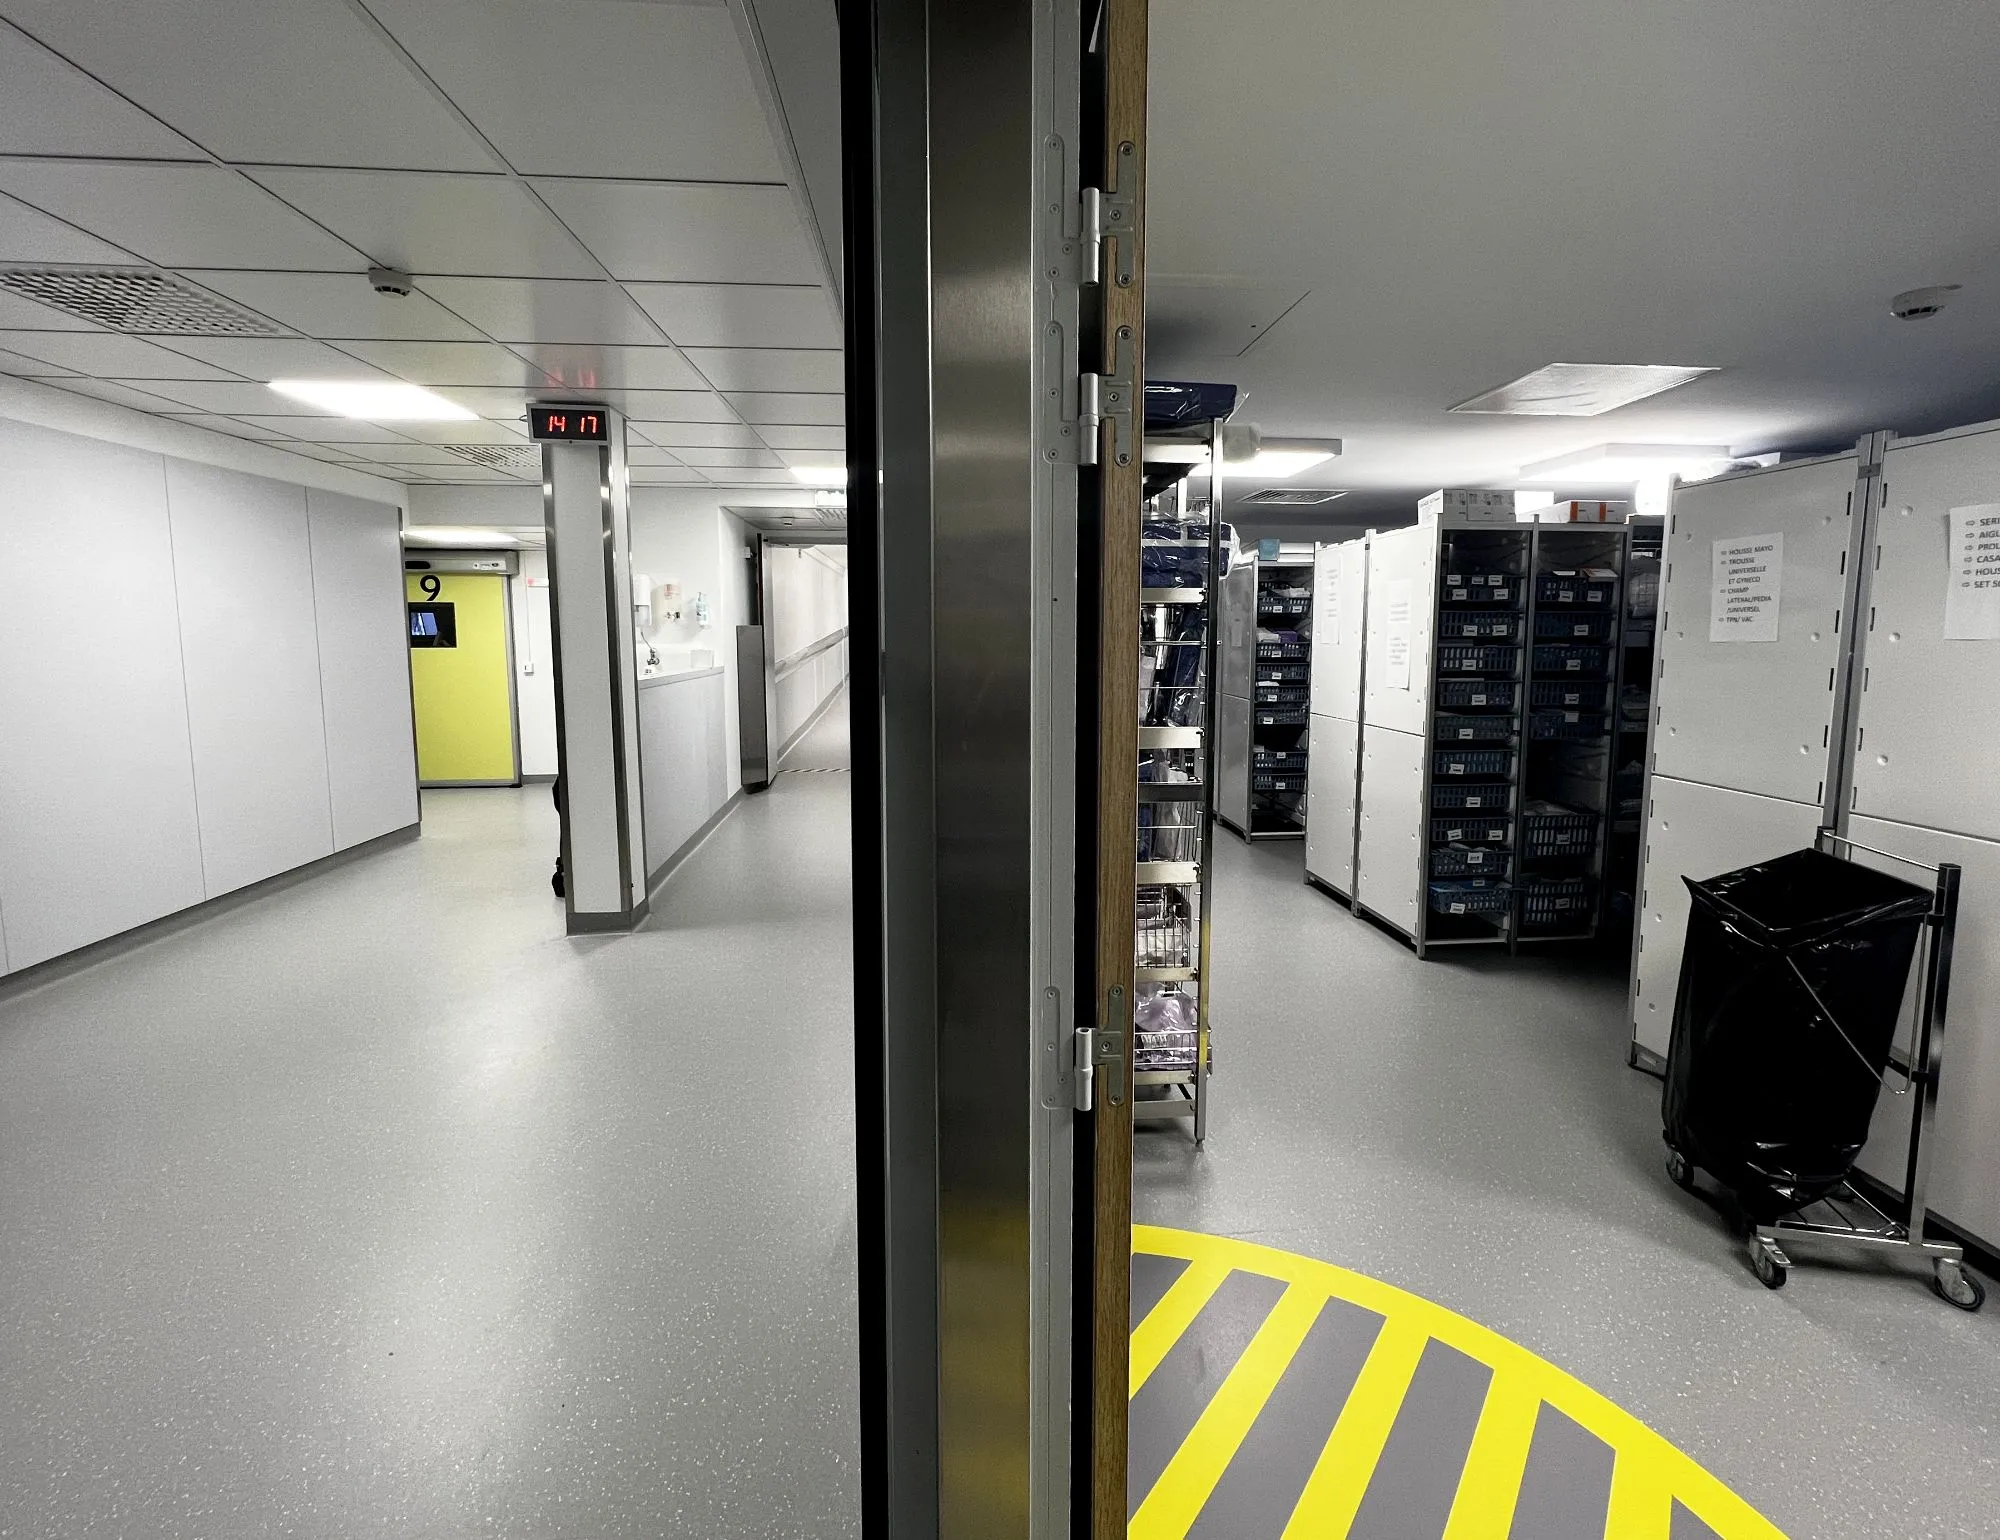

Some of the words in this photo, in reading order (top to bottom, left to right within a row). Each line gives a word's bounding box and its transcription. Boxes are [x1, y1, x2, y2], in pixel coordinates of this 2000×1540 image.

[548, 414, 566, 433] 14
[580, 415, 598, 434] 17
[420, 574, 441, 601] 9
